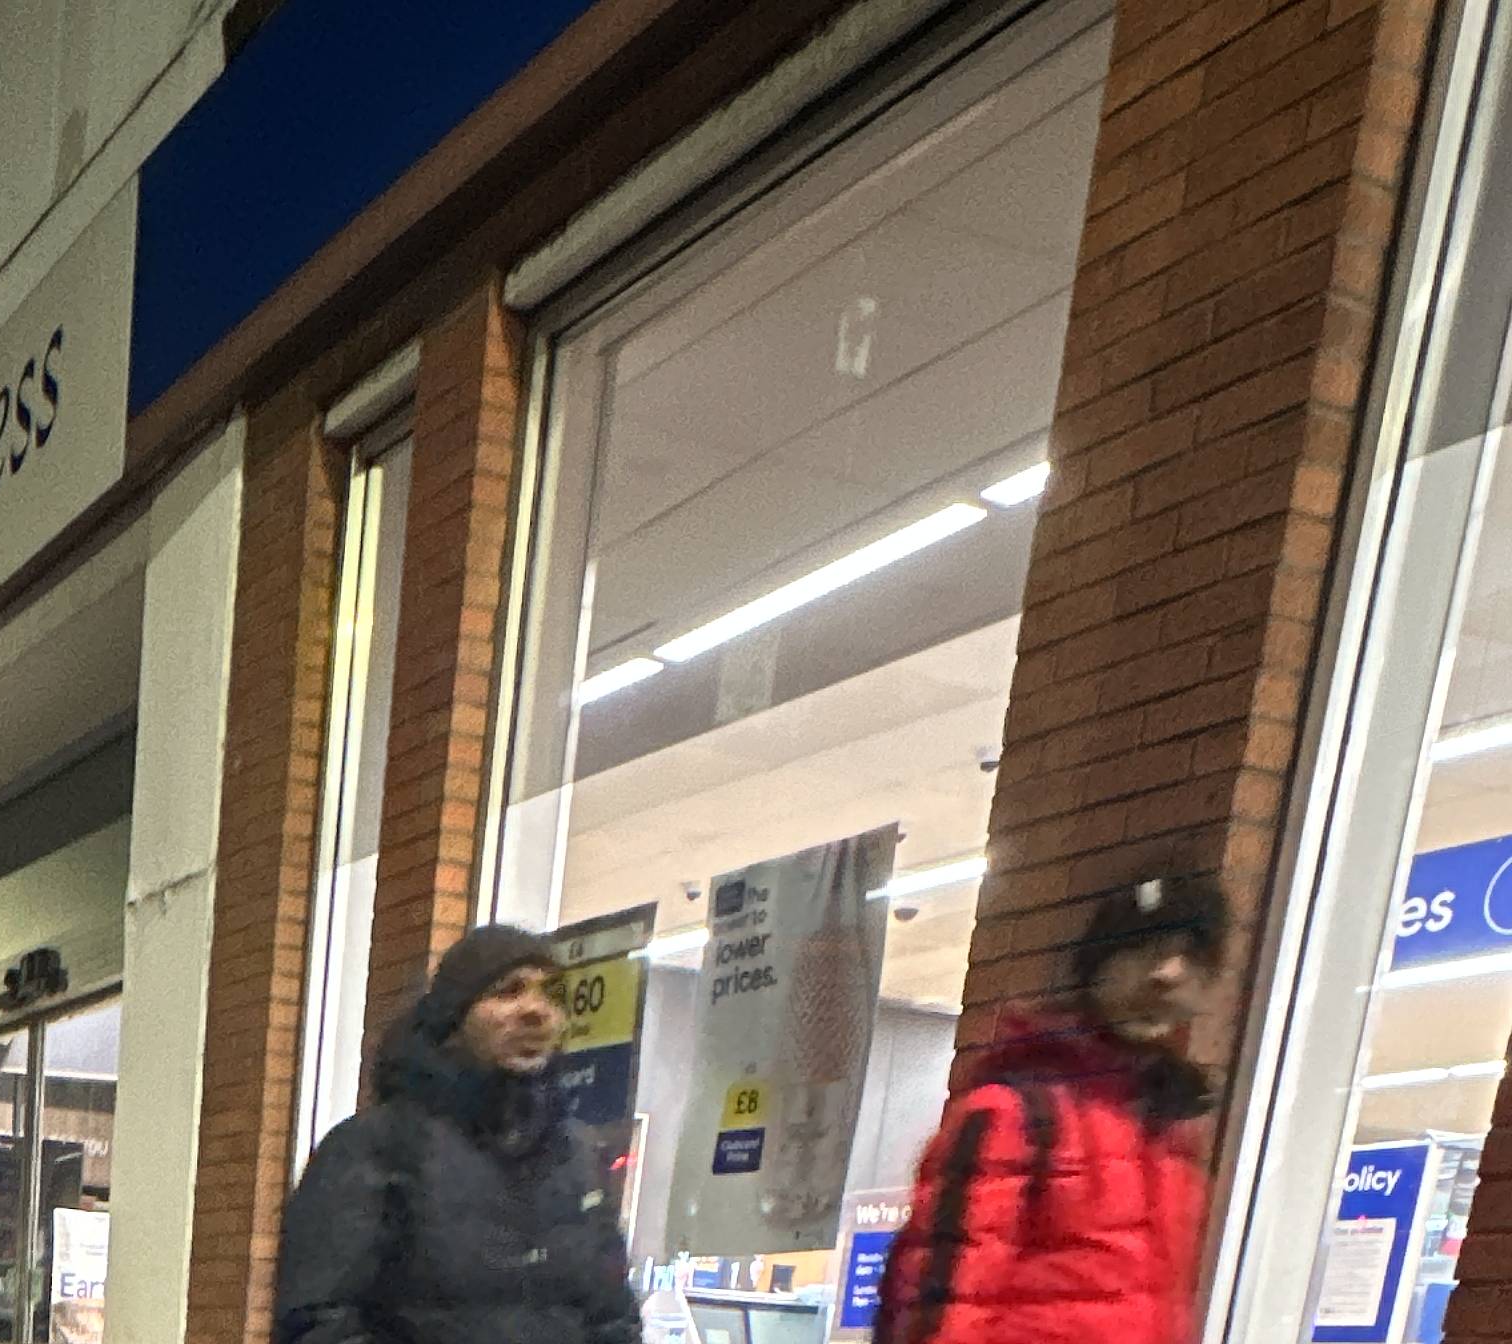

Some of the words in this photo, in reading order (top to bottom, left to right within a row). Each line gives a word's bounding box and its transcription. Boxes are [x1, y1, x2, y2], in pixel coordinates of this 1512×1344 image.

[1396, 890, 1456, 938] es
[715, 933, 772, 968] lower
[711, 965, 778, 1006] prices.
[1343, 1164, 1402, 1197] olicy
[60, 1273, 105, 1299] Ear
